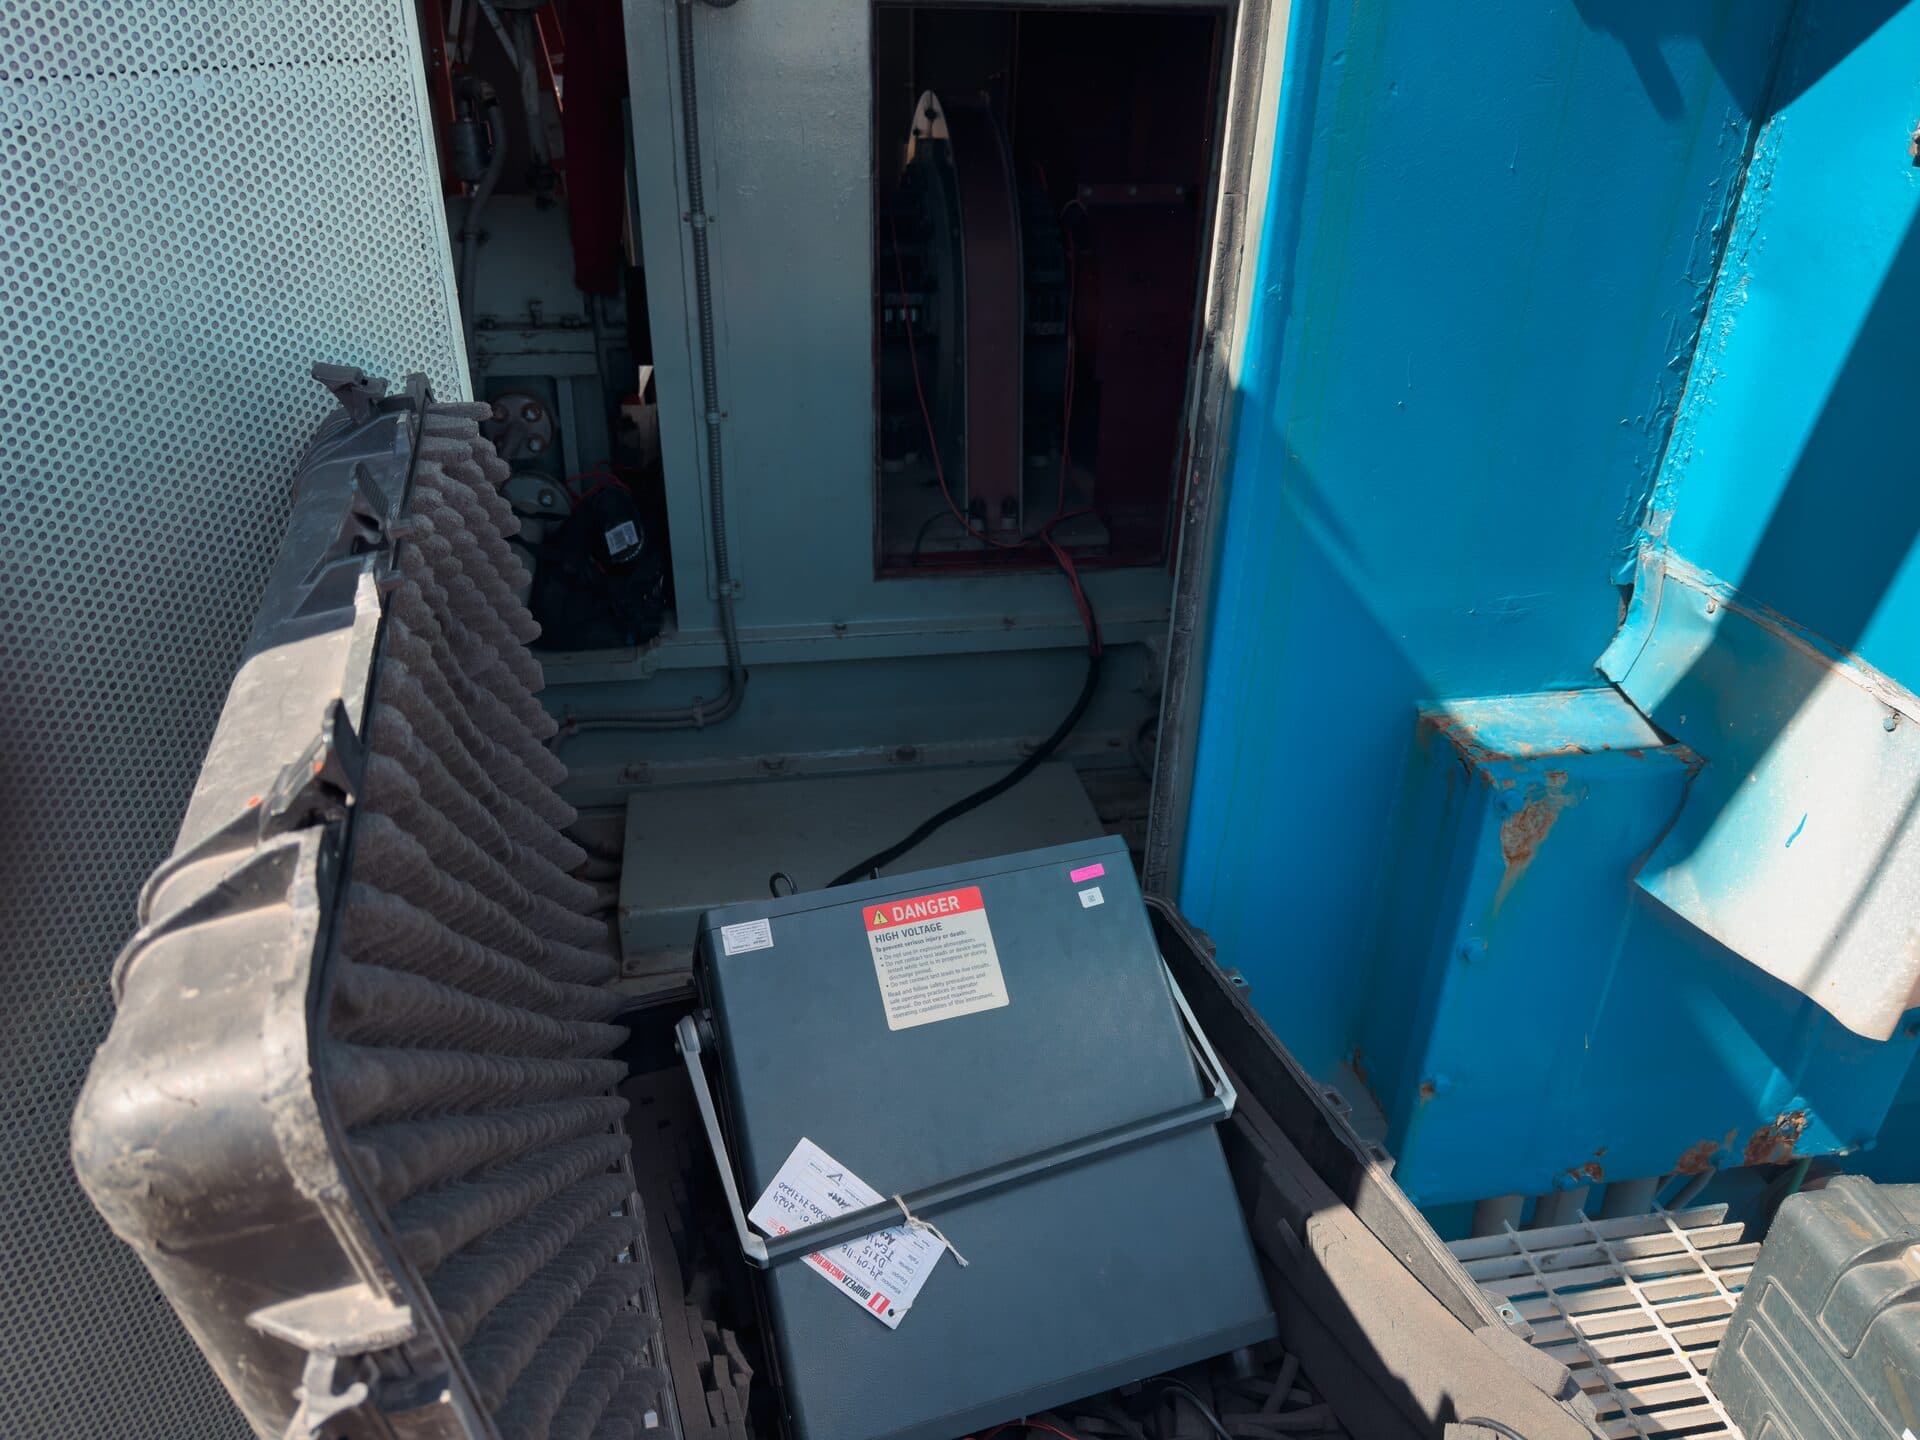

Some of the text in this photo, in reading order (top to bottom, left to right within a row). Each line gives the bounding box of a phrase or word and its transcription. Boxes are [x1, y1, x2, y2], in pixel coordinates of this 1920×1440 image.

[891, 895, 960, 921] DANGER
[874, 922, 942, 943] HIGH VOLTAGE
[882, 942, 903, 951] prevent
[904, 938, 924, 947] serious
[925, 934, 941, 943] injury
[949, 929, 966, 938] death:
[904, 954, 923, 963] contact
[933, 949, 948, 957] leads
[954, 944, 971, 953] device
[971, 941, 986, 949] being
[918, 943, 942, 953] explosive
[887, 966, 903, 974] tested
[903, 963, 917, 971] while
[941, 953, 962, 963] progress
[888, 971, 913, 981] discharge
[909, 974, 929, 983] connect
[929, 980, 944, 988] safety
[945, 974, 974, 985] precautions
[901, 992, 926, 1002] operating
[926, 987, 949, 996] practices
[956, 981, 977, 989] operator
[931, 994, 950, 1002] exceed
[950, 988, 976, 998] maximum
[892, 1008, 917, 1018] operating
